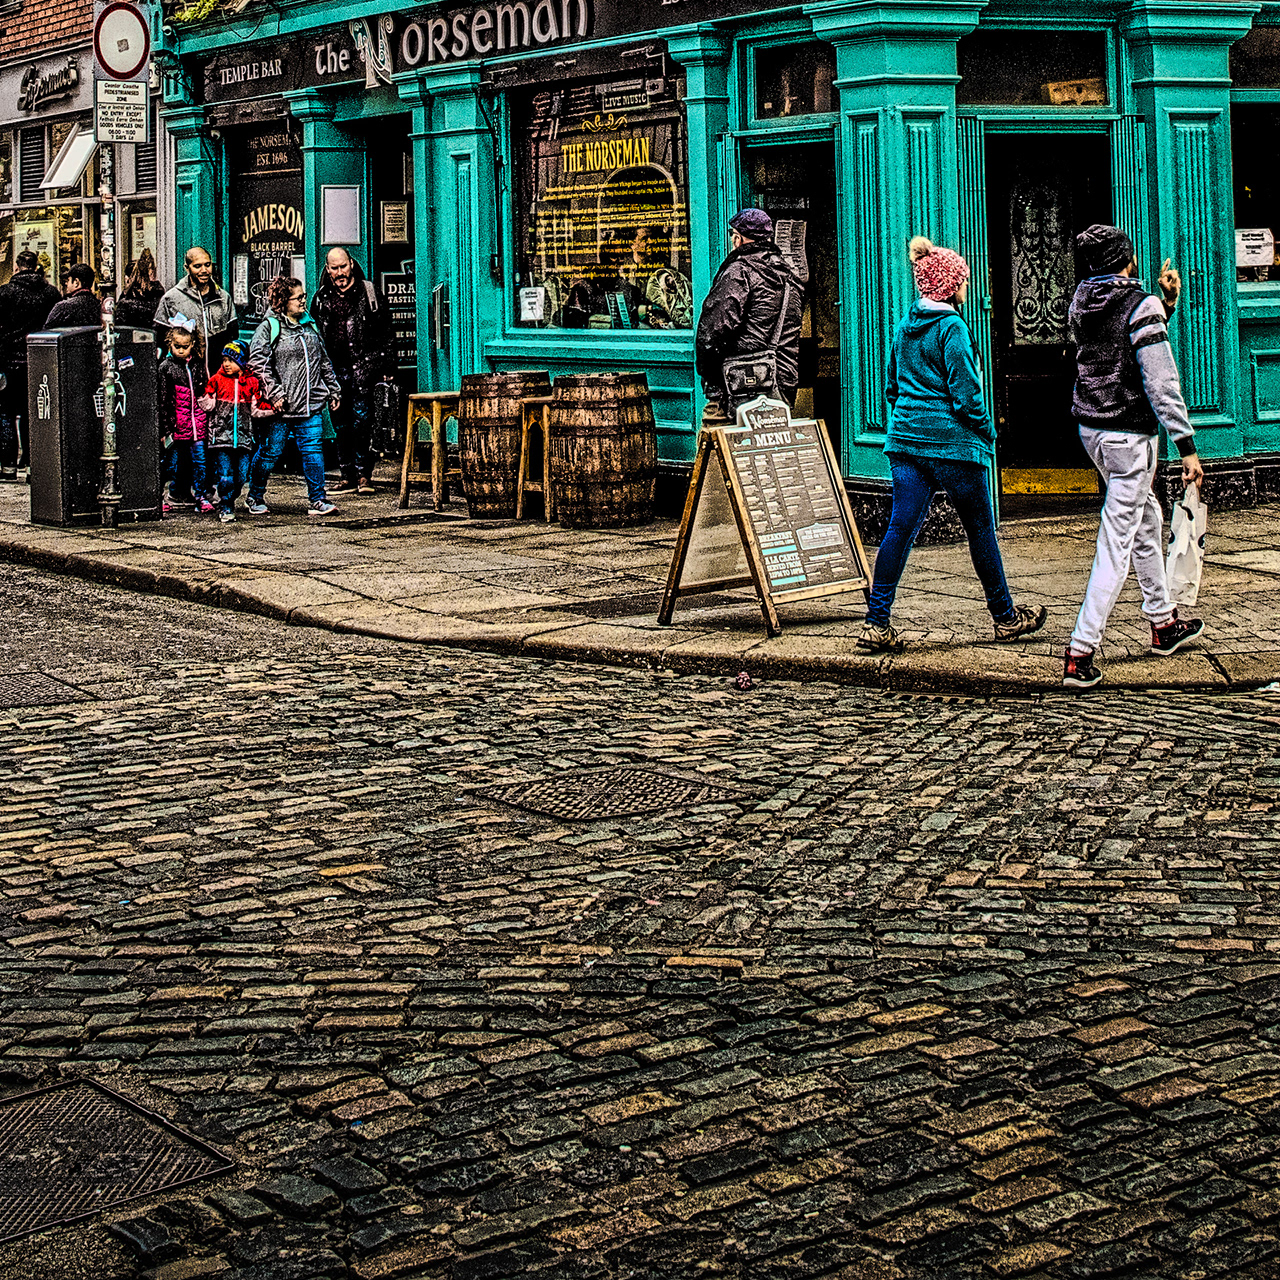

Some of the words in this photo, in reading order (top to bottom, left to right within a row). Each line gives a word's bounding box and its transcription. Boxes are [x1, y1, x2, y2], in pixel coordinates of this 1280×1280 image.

[316, 44, 350, 74] The
[220, 63, 259, 85] TEMPLE
[261, 59, 281, 77] BAR
[605, 97, 621, 107] LIVE
[623, 93, 647, 105] MUSIC
[272, 153, 288, 164] 1696
[561, 145, 583, 172] THE
[586, 137, 649, 171] NORSEMAN
[242, 204, 303, 243] JAMESON
[251, 243, 270, 251] BLACK
[272, 242, 295, 251] BARREL
[754, 431, 792, 447] MENU
[770, 555, 778, 563] LA
[779, 552, 799, 562] CARTE
